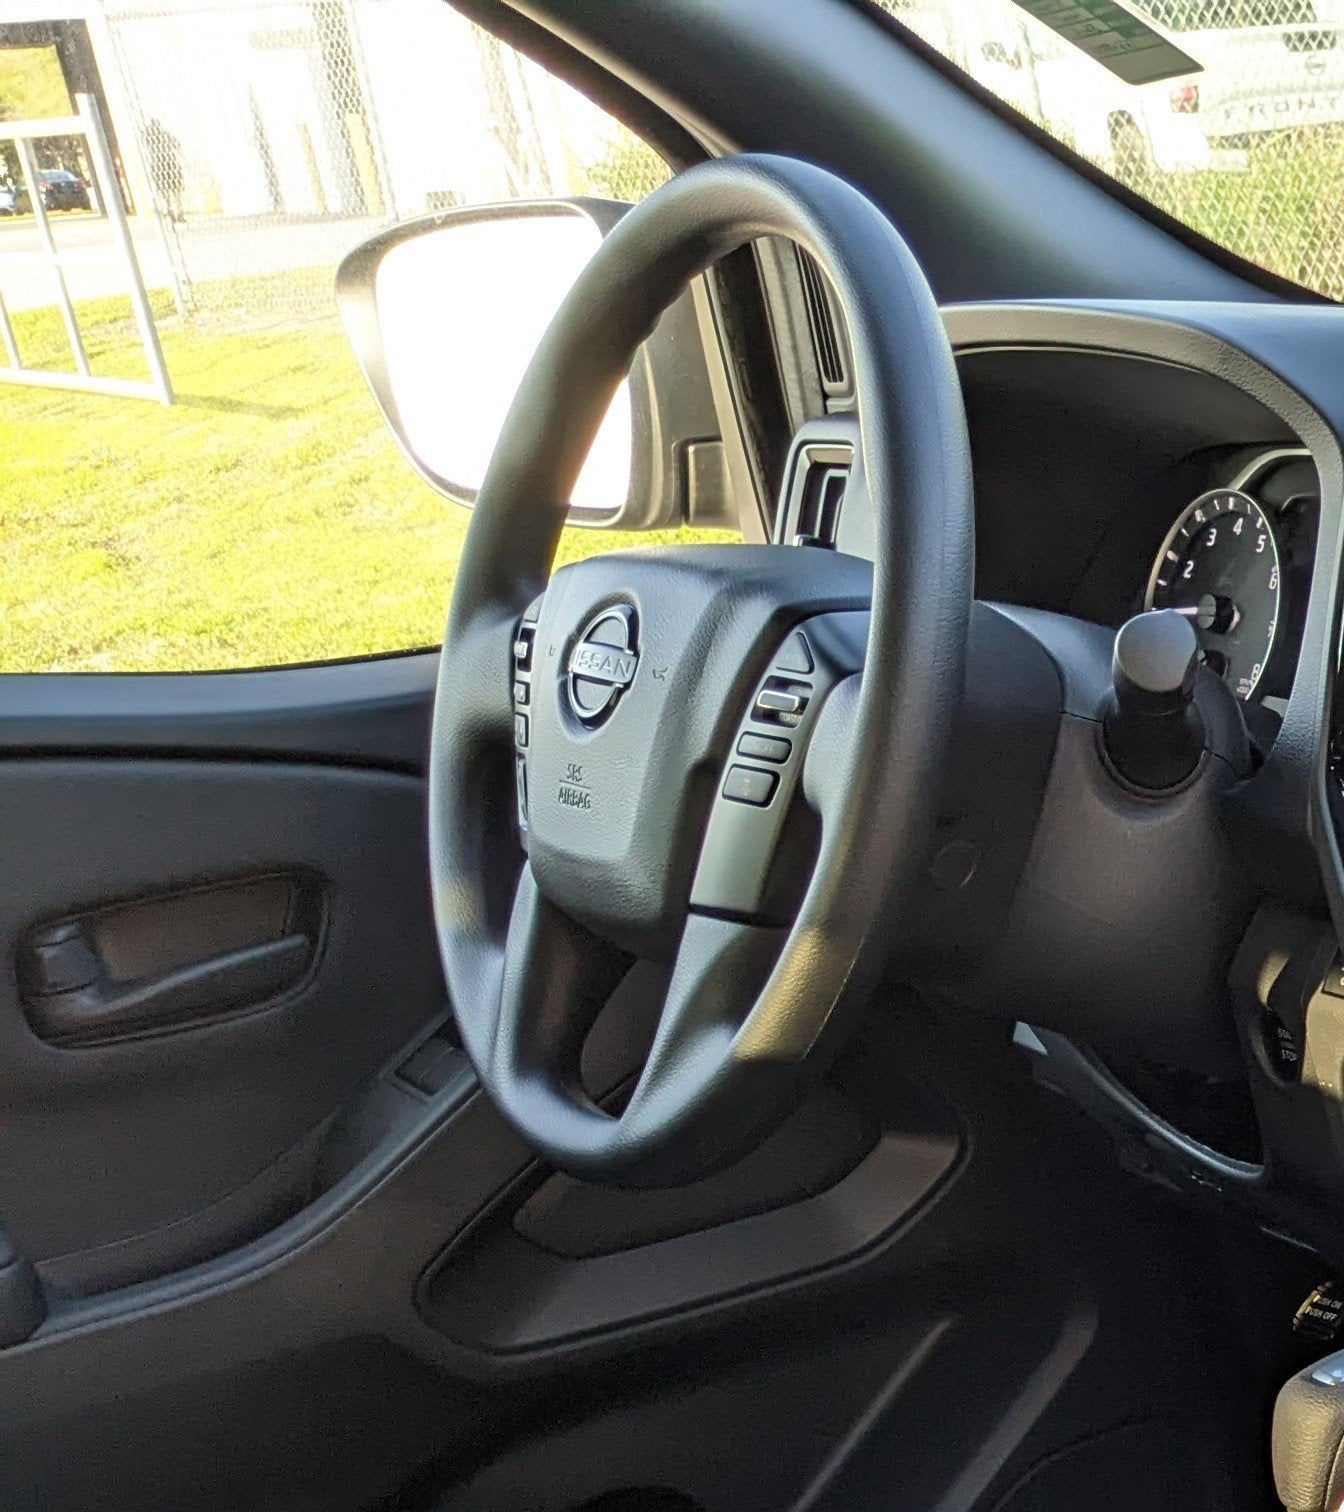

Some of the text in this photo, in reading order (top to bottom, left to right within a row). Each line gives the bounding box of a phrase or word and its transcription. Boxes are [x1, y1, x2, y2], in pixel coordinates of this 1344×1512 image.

[1233, 517, 1244, 536] 4
[1207, 528, 1218, 546] 3
[1256, 534, 1267, 553] 5
[1183, 560, 1194, 579] 2
